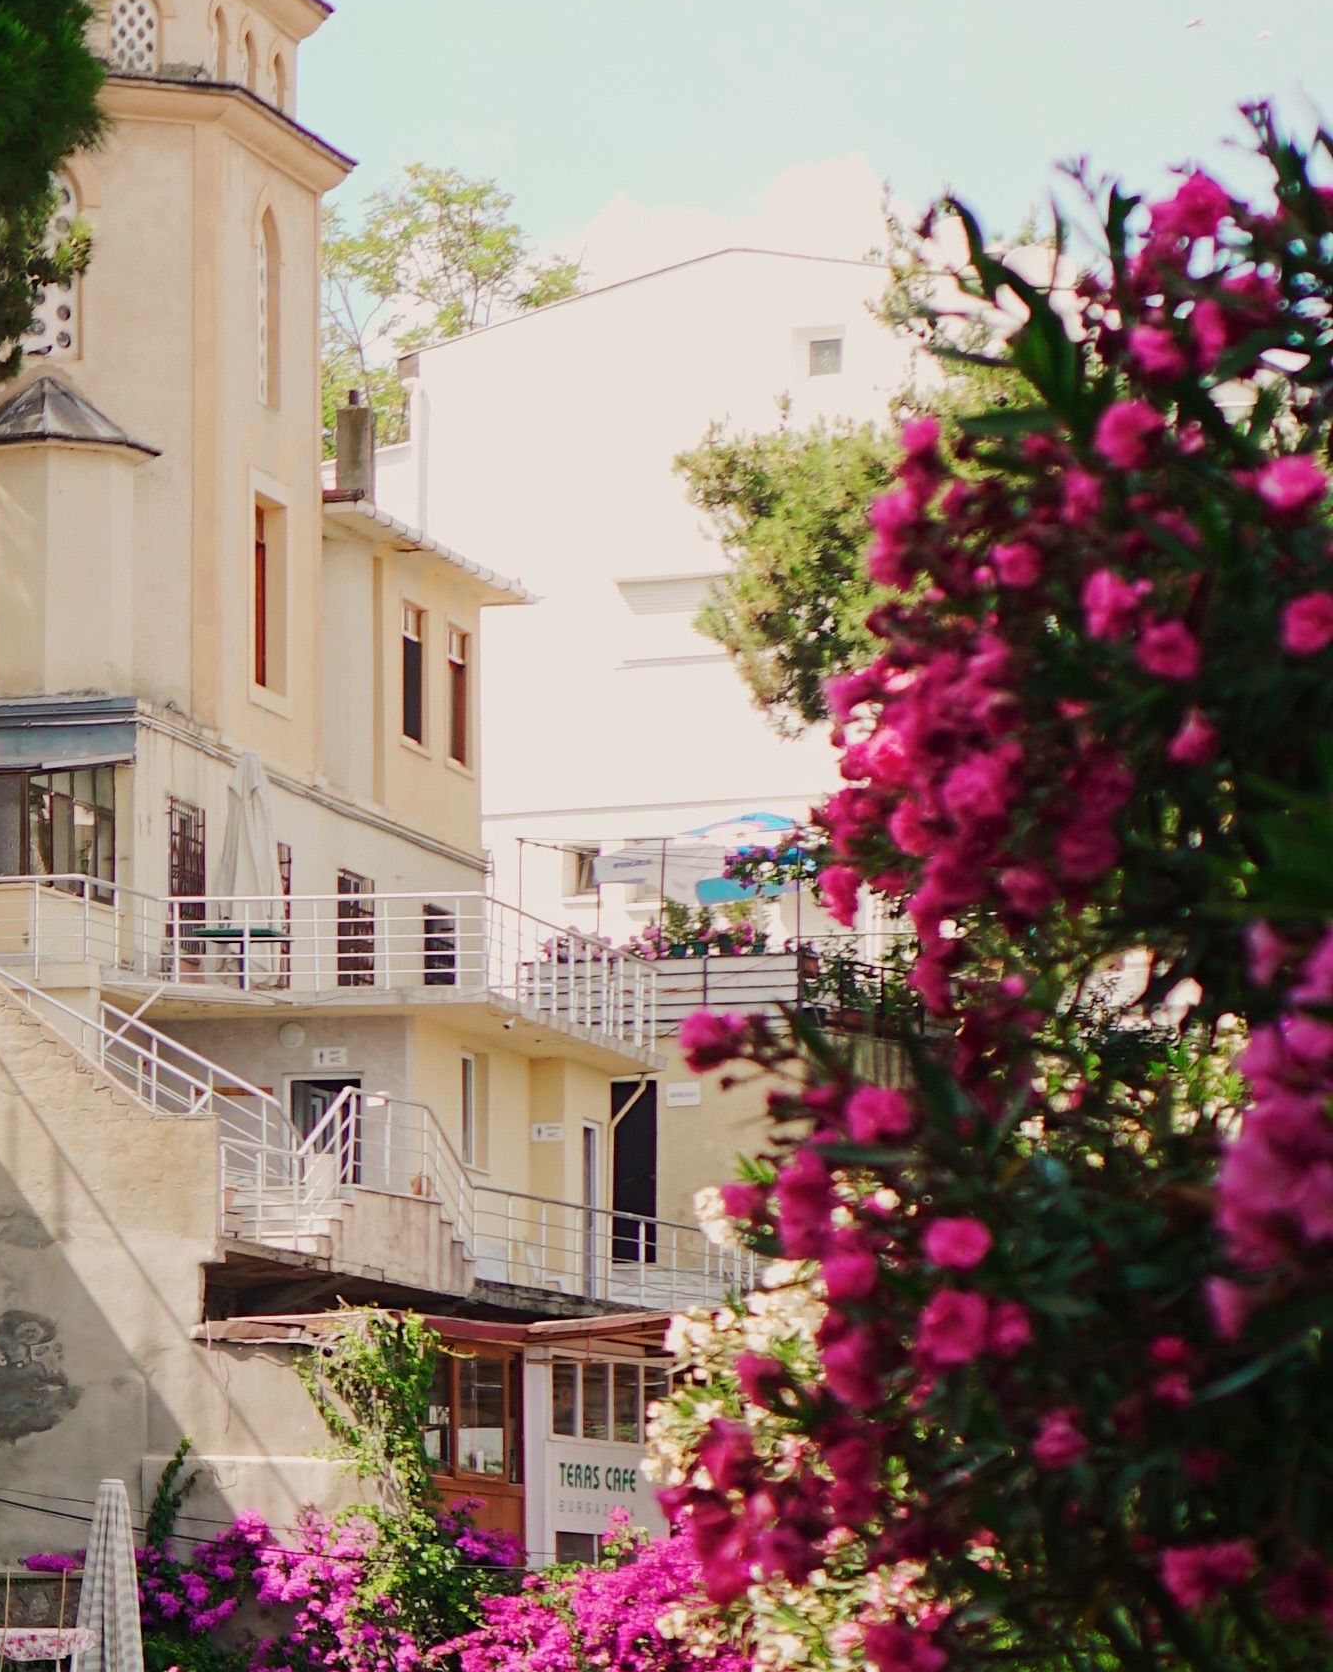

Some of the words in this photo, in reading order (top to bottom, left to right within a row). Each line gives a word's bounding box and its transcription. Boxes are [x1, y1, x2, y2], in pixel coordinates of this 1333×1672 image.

[559, 1462, 600, 1489] TERAS
[605, 1466, 636, 1493] CAFE
[559, 1499, 635, 1517] BURGAZA
